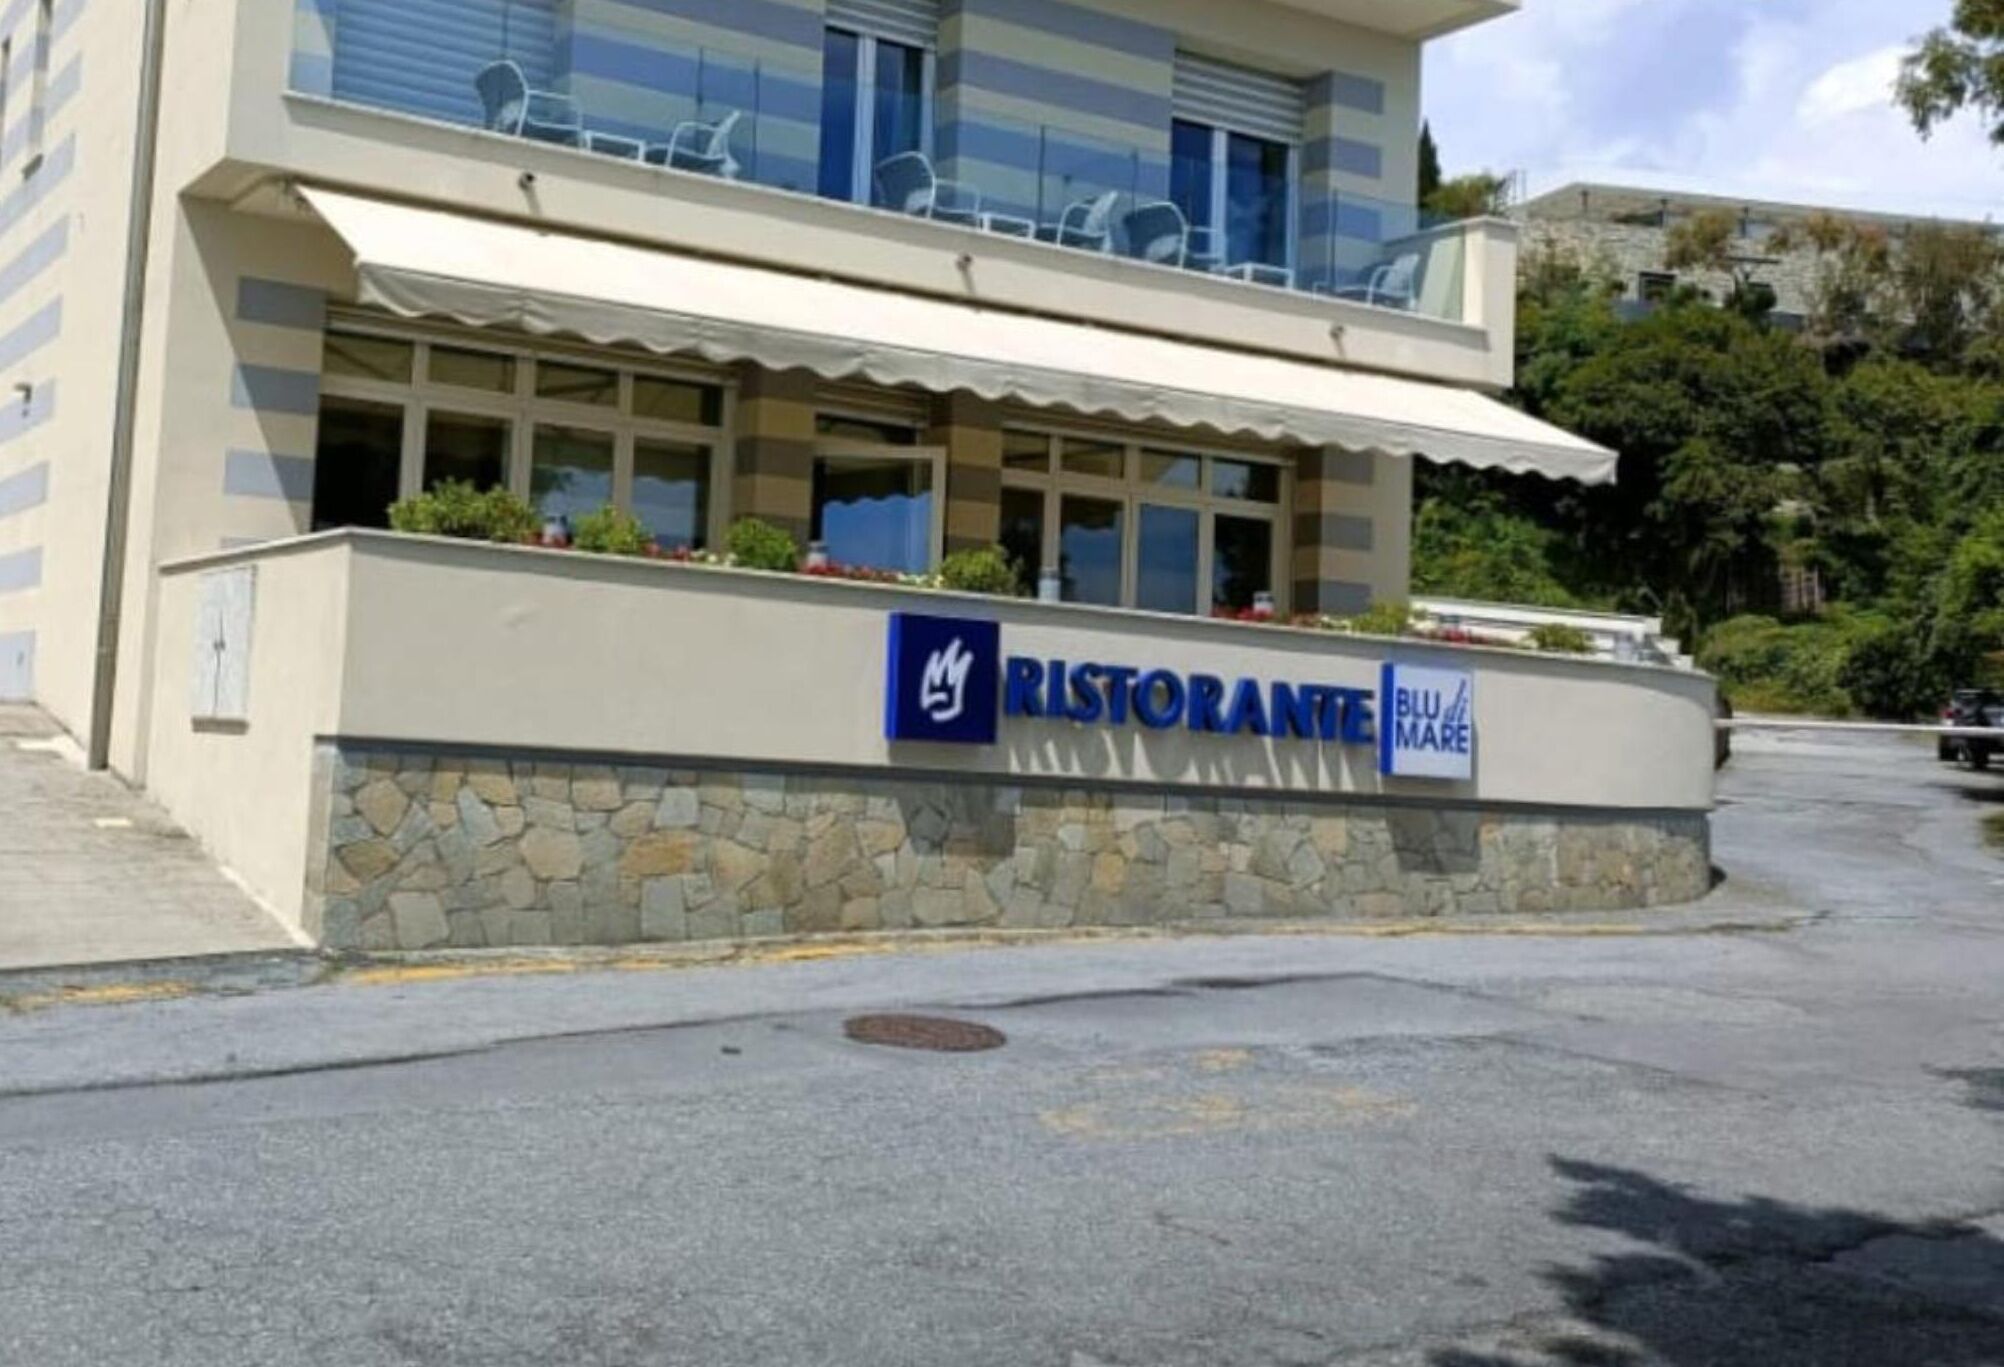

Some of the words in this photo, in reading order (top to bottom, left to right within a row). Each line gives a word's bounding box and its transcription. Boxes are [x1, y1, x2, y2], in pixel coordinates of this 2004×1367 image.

[1004, 656, 1376, 744] RISTORANTE
[1396, 687, 1441, 719] BLU
[1443, 678, 1468, 723] di
[1396, 720, 1470, 754] MARE
